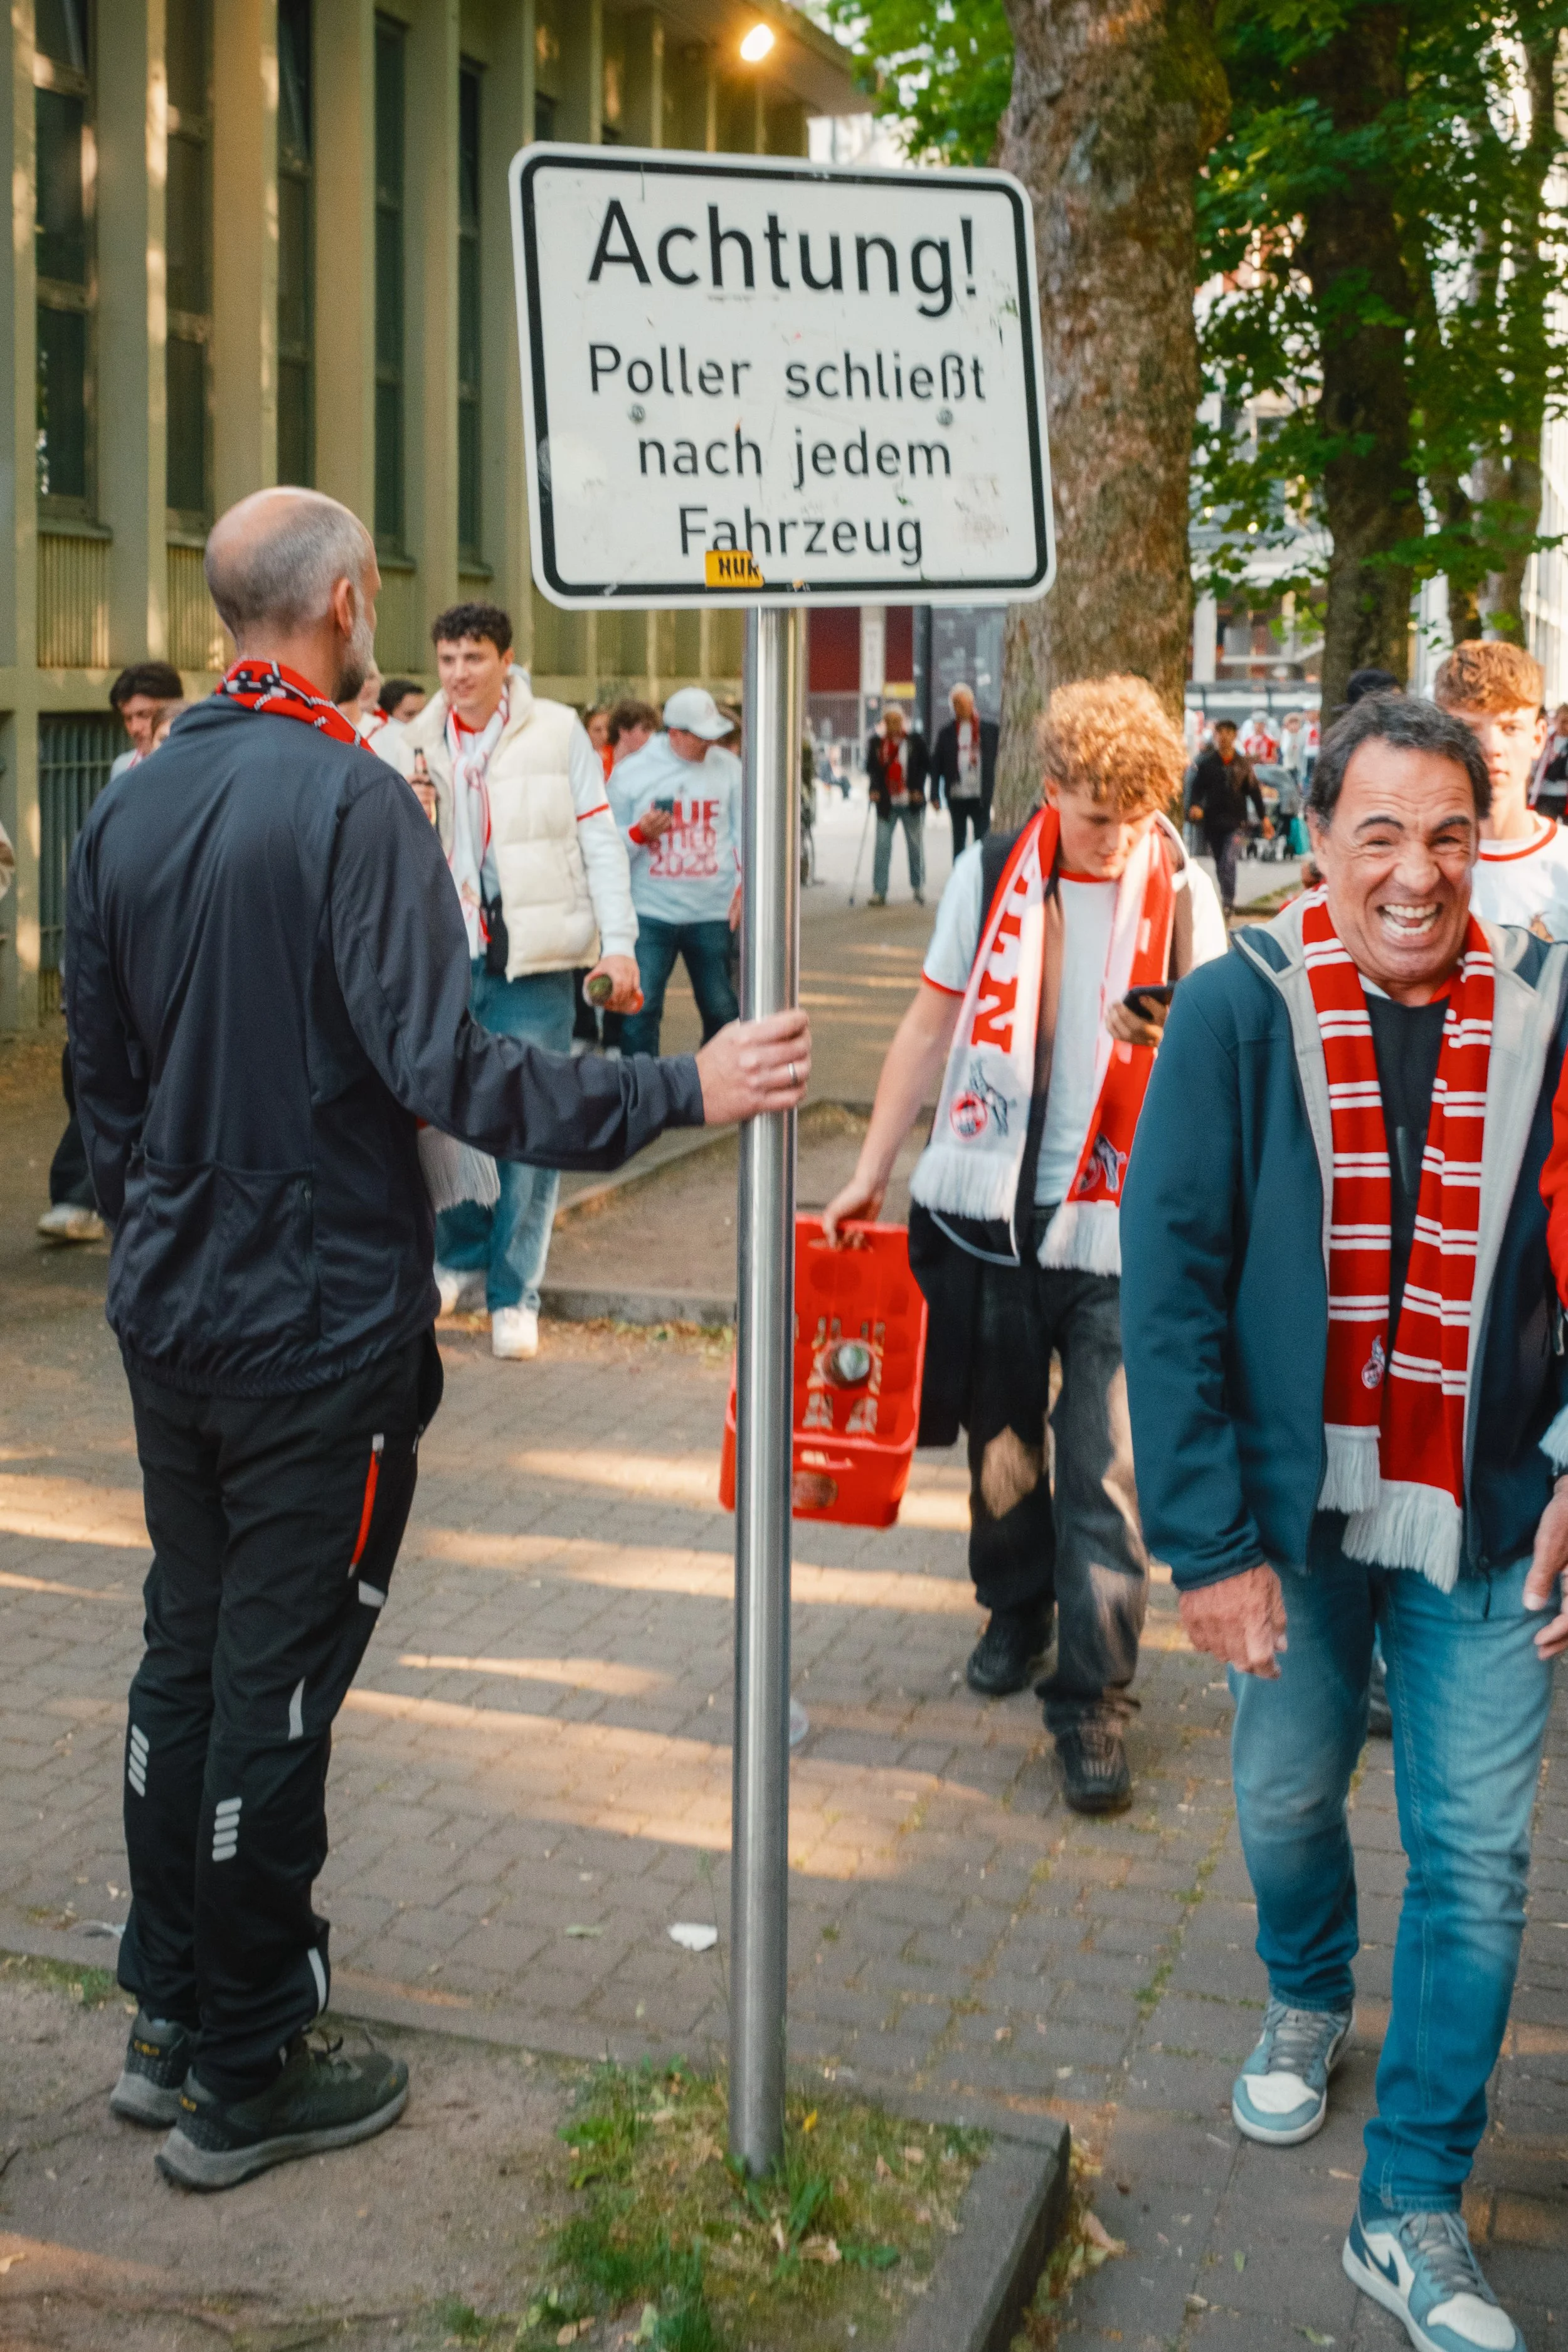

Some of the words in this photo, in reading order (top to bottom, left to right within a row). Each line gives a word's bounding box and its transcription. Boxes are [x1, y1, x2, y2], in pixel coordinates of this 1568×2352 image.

[587, 198, 978, 319] Achtung!
[588, 343, 752, 396] Poller
[785, 351, 987, 400] schließt
[638, 426, 763, 475] nach
[793, 426, 952, 490] jedem
[679, 506, 924, 567] Fahrzeug
